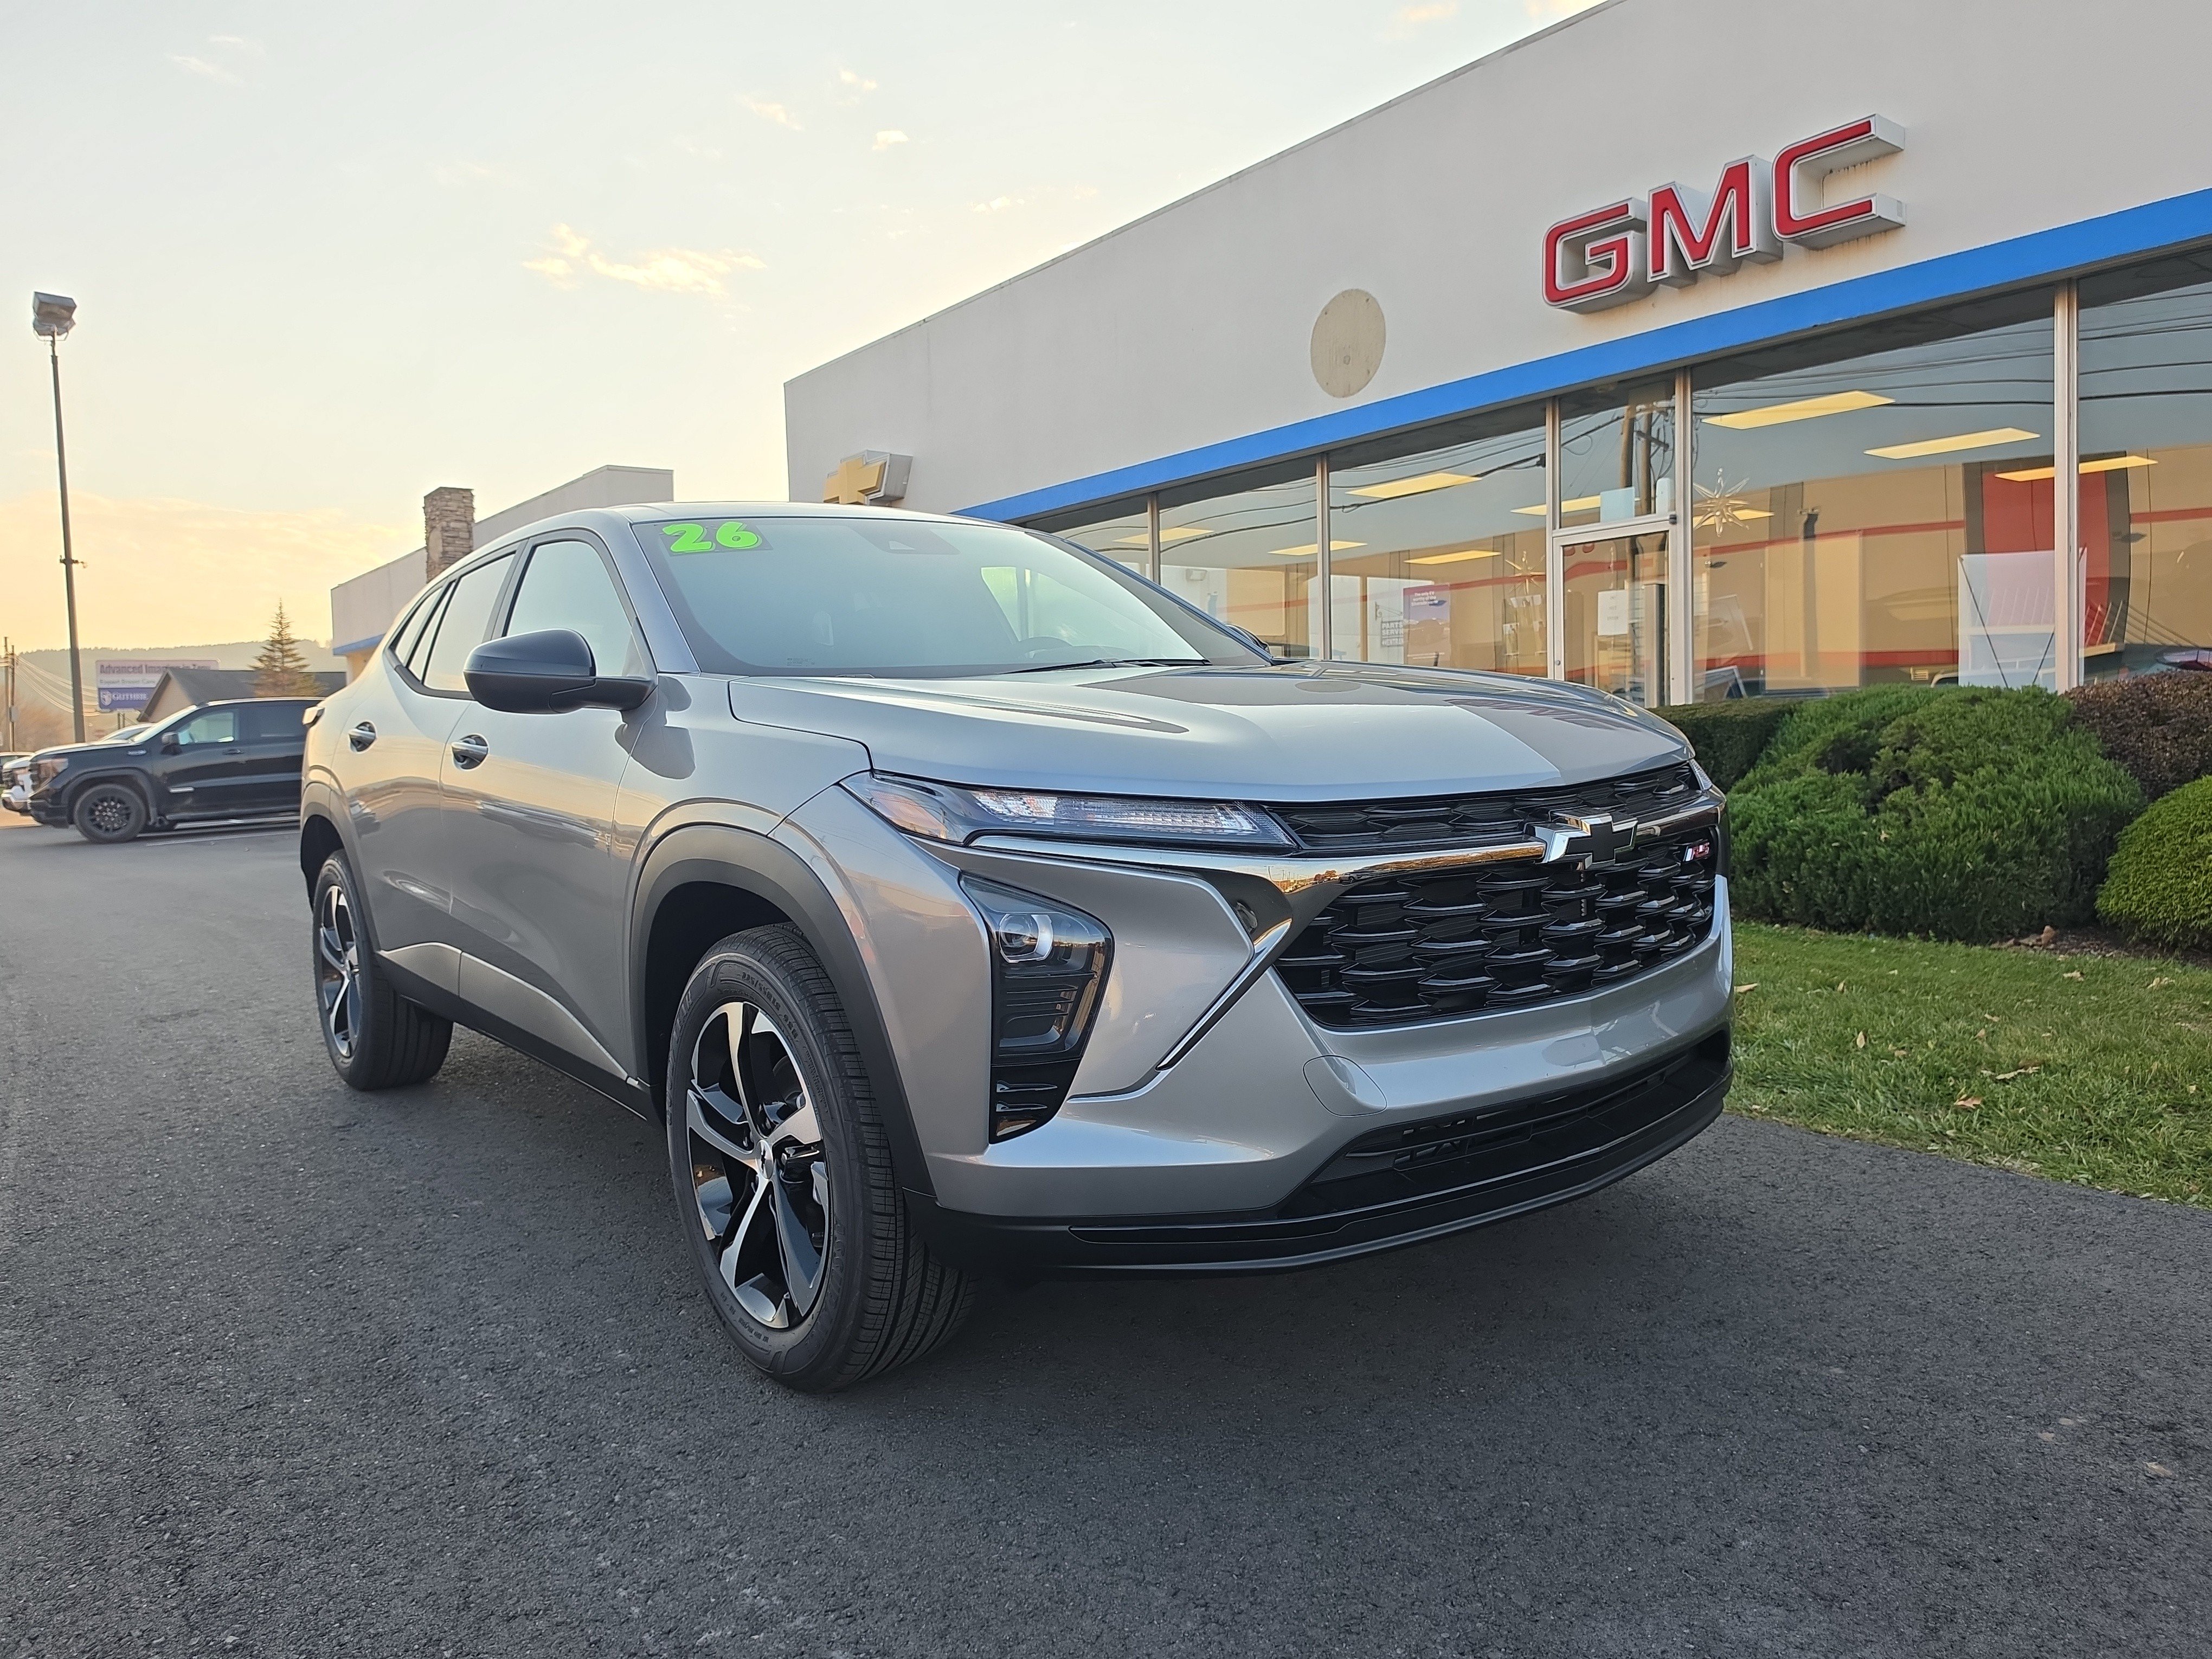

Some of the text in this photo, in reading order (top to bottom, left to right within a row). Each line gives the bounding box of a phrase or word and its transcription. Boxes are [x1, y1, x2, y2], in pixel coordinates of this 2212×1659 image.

[1542, 113, 1878, 307] GMC
[662, 522, 762, 554] 26
[100, 664, 143, 673] Advanced
